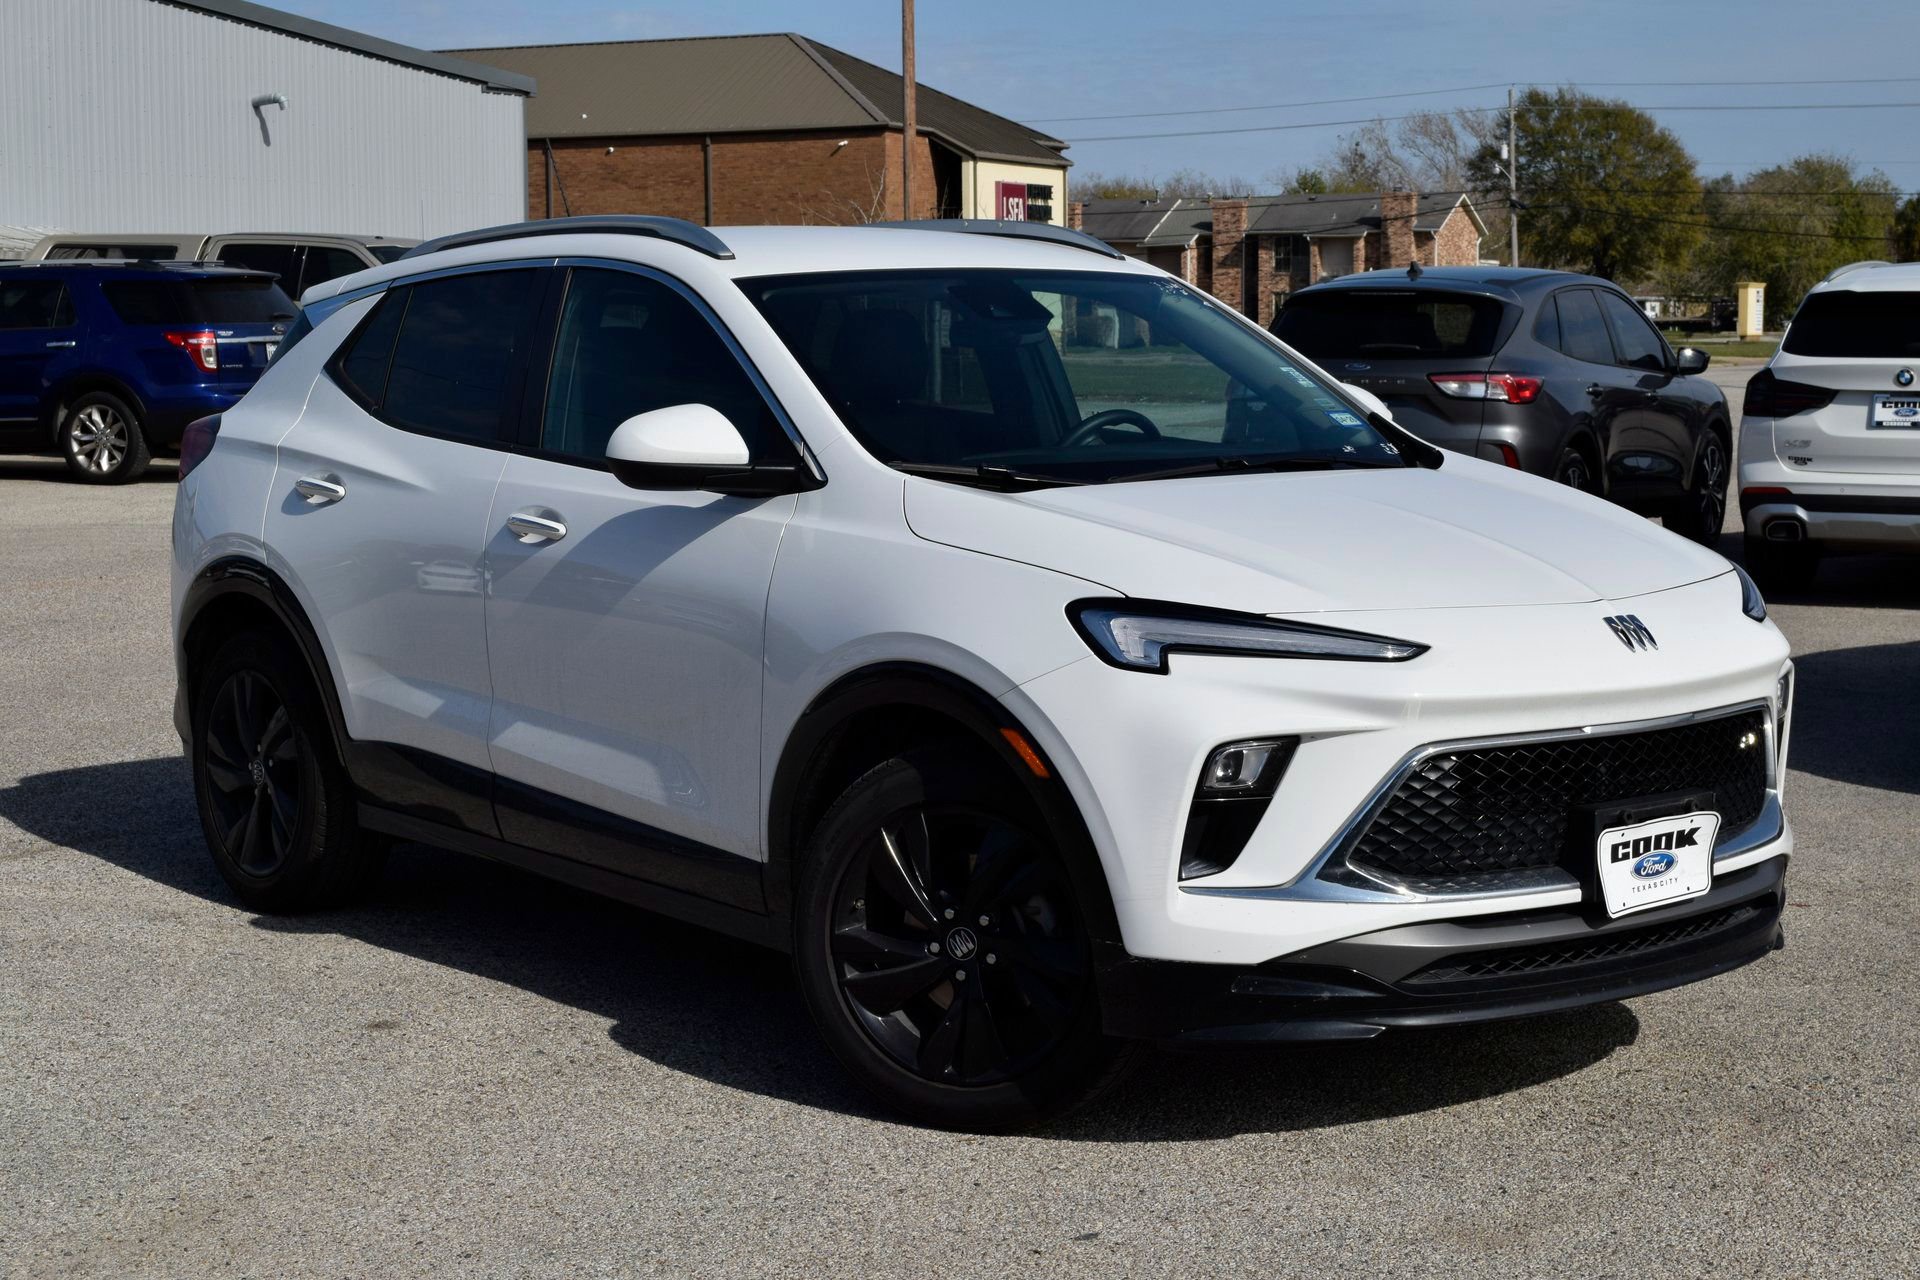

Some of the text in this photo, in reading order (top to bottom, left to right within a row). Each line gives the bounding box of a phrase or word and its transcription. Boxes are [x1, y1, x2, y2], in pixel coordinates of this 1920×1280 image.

[1003, 197, 1024, 221] LSFA
[1882, 401, 1920, 409] COO
[1611, 827, 1701, 864] COOK
[1640, 856, 1668, 876] Ford
